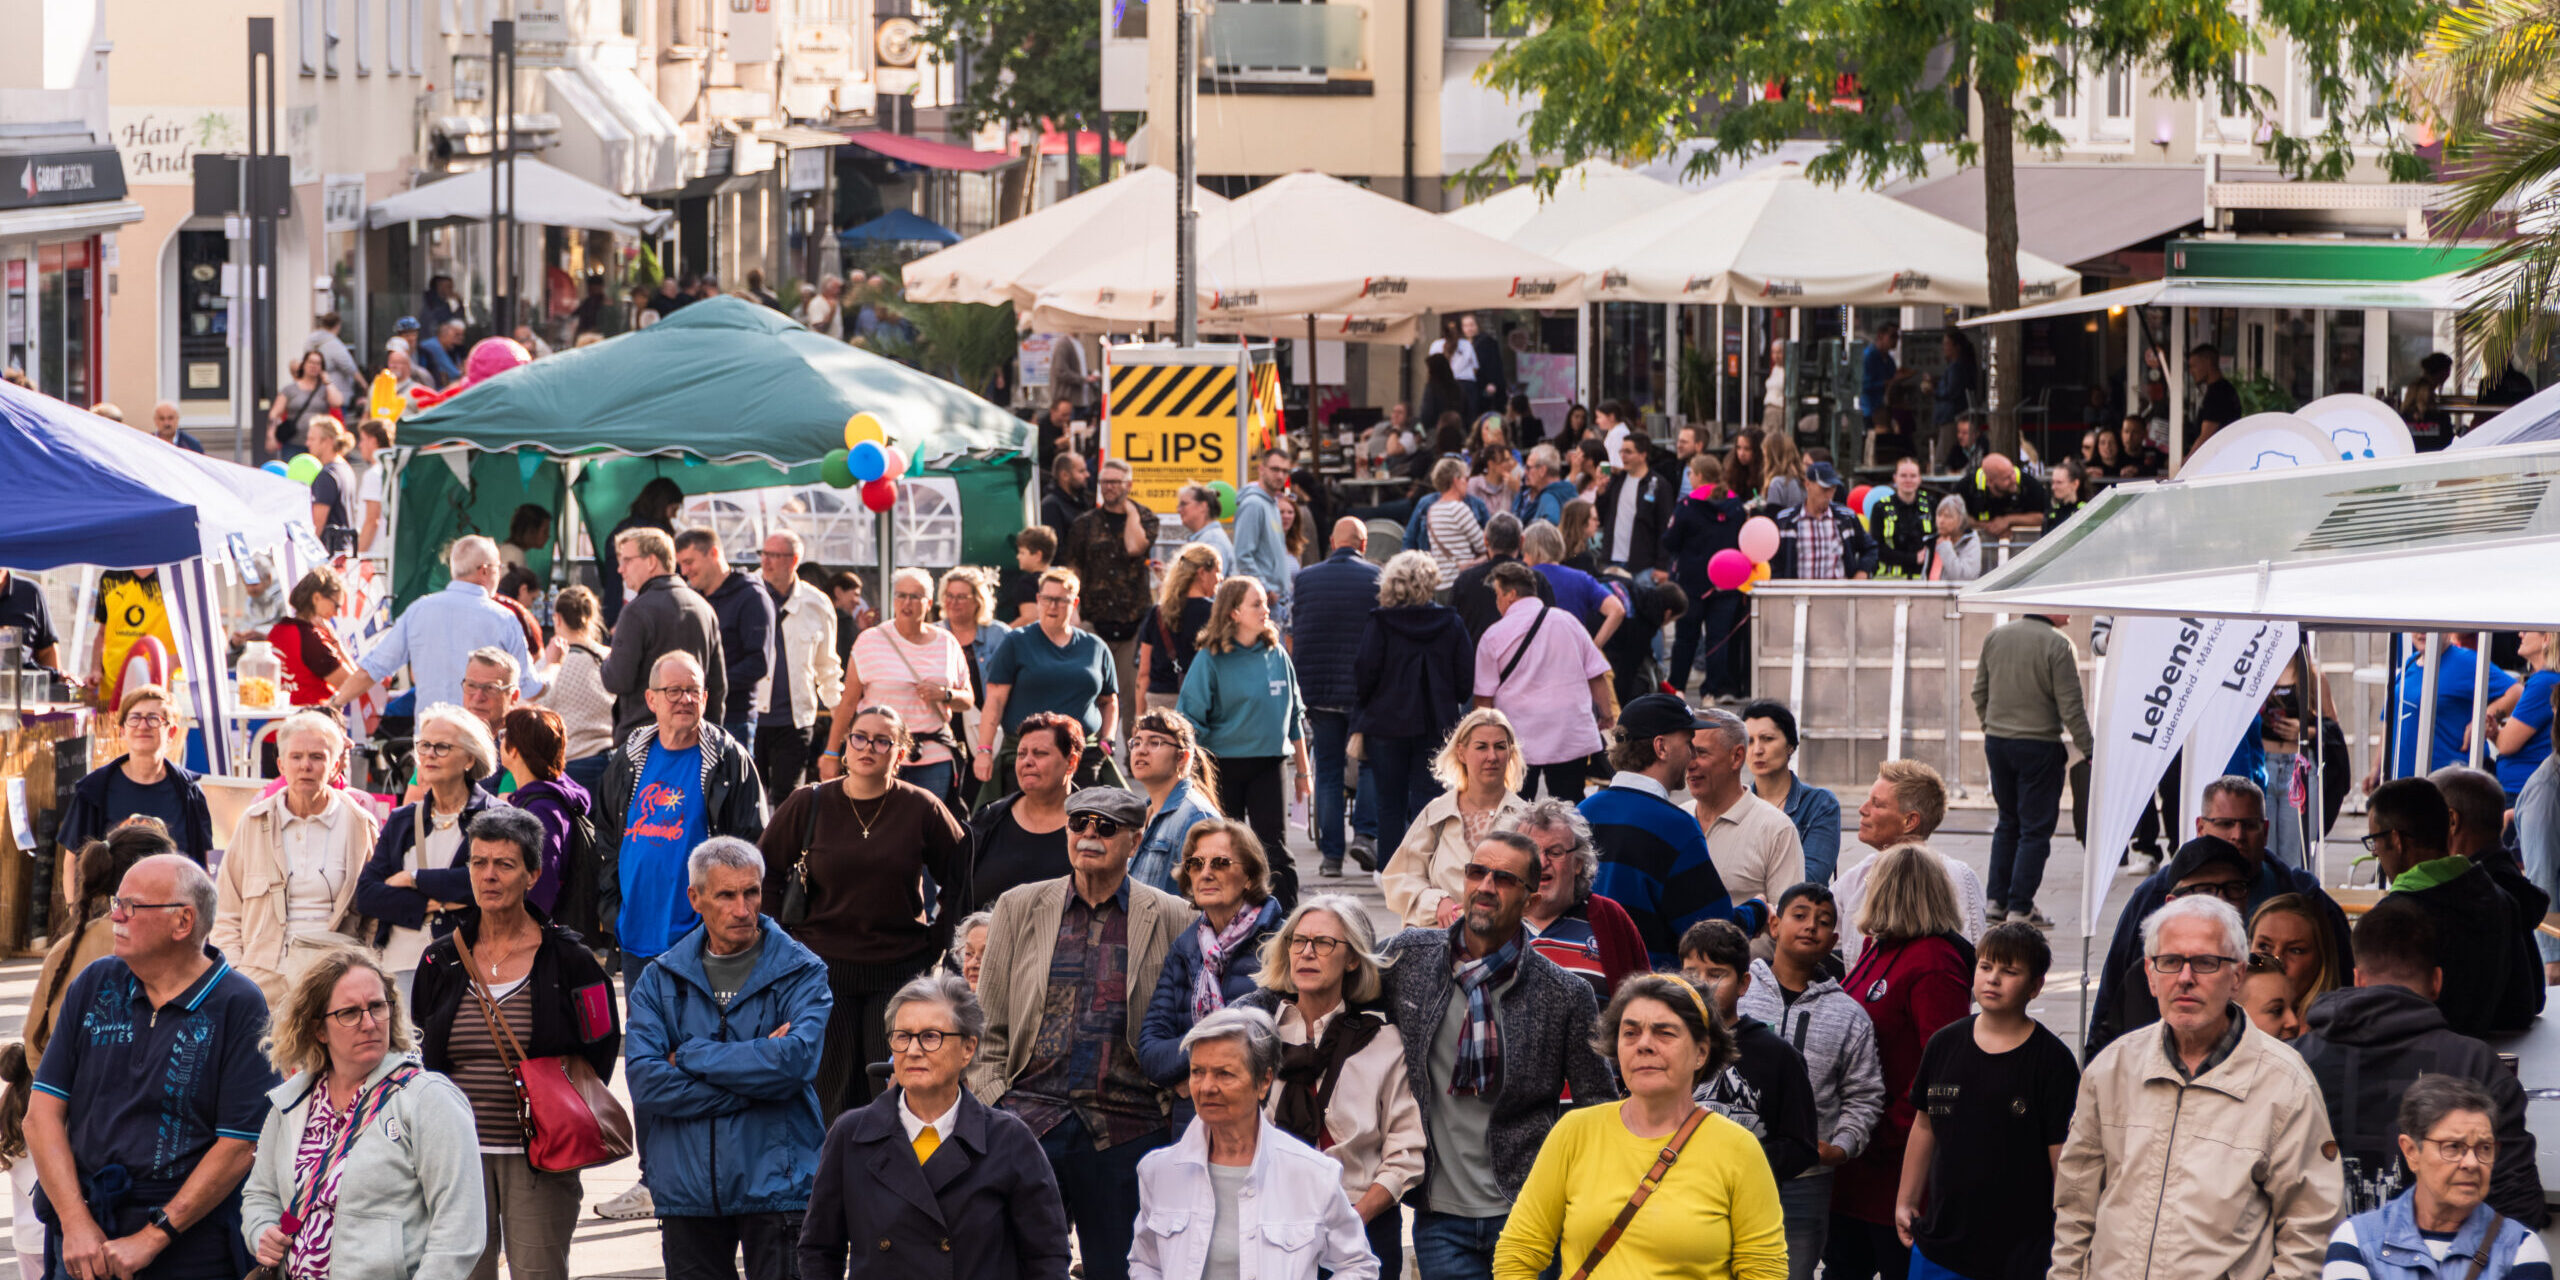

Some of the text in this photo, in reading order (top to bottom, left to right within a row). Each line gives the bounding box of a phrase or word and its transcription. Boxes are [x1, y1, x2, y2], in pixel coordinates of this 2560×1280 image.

[122, 114, 184, 147] Hair
[1162, 433, 1223, 462] IPS
[2158, 675, 2198, 751] Lüdenscheid
[2197, 619, 2227, 667] Märkisc
[2246, 630, 2283, 698] Lüdenscheid
[158, 1030, 187, 1139] PARADISE
